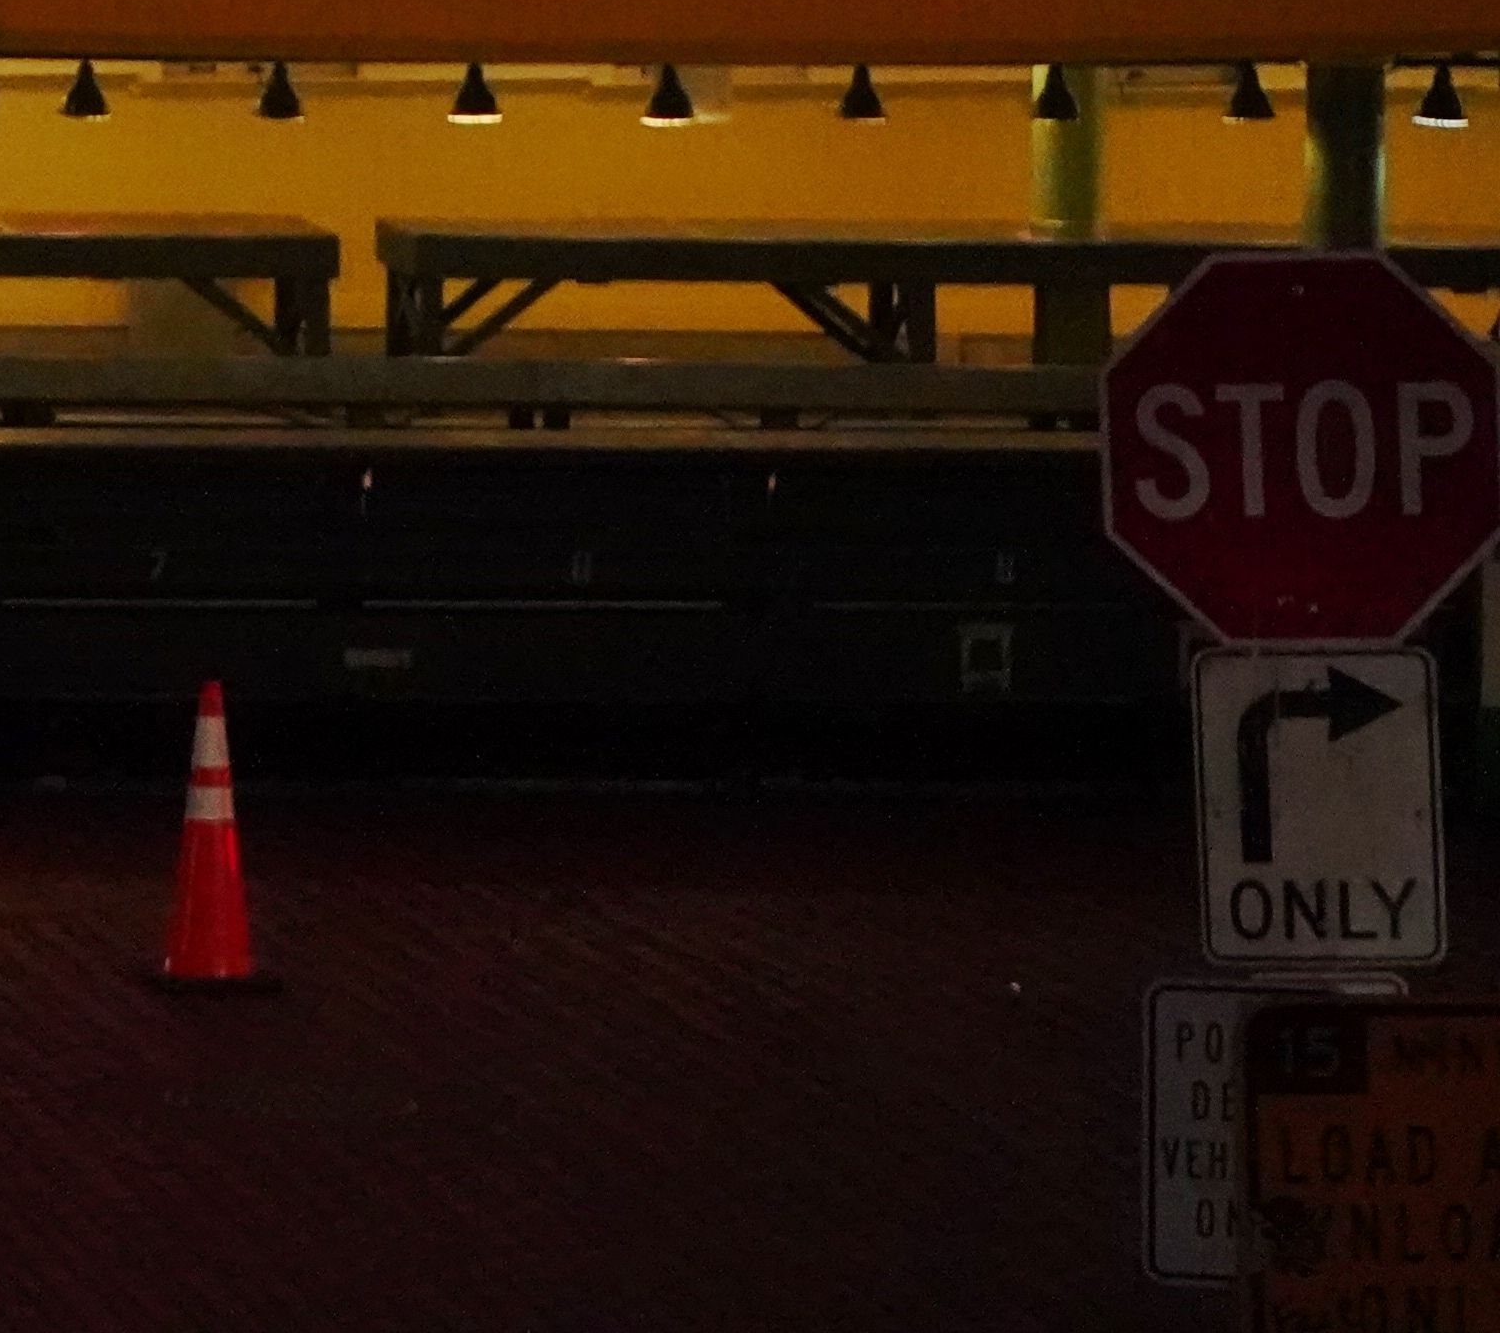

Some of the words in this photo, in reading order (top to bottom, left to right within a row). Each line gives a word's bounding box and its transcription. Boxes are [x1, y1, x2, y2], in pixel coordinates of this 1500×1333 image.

[1134, 379, 1476, 523] STOP
[1229, 877, 1417, 940] ONLY
[1278, 1025, 1341, 1078] 15
[1282, 1124, 1436, 1184] LOAD
